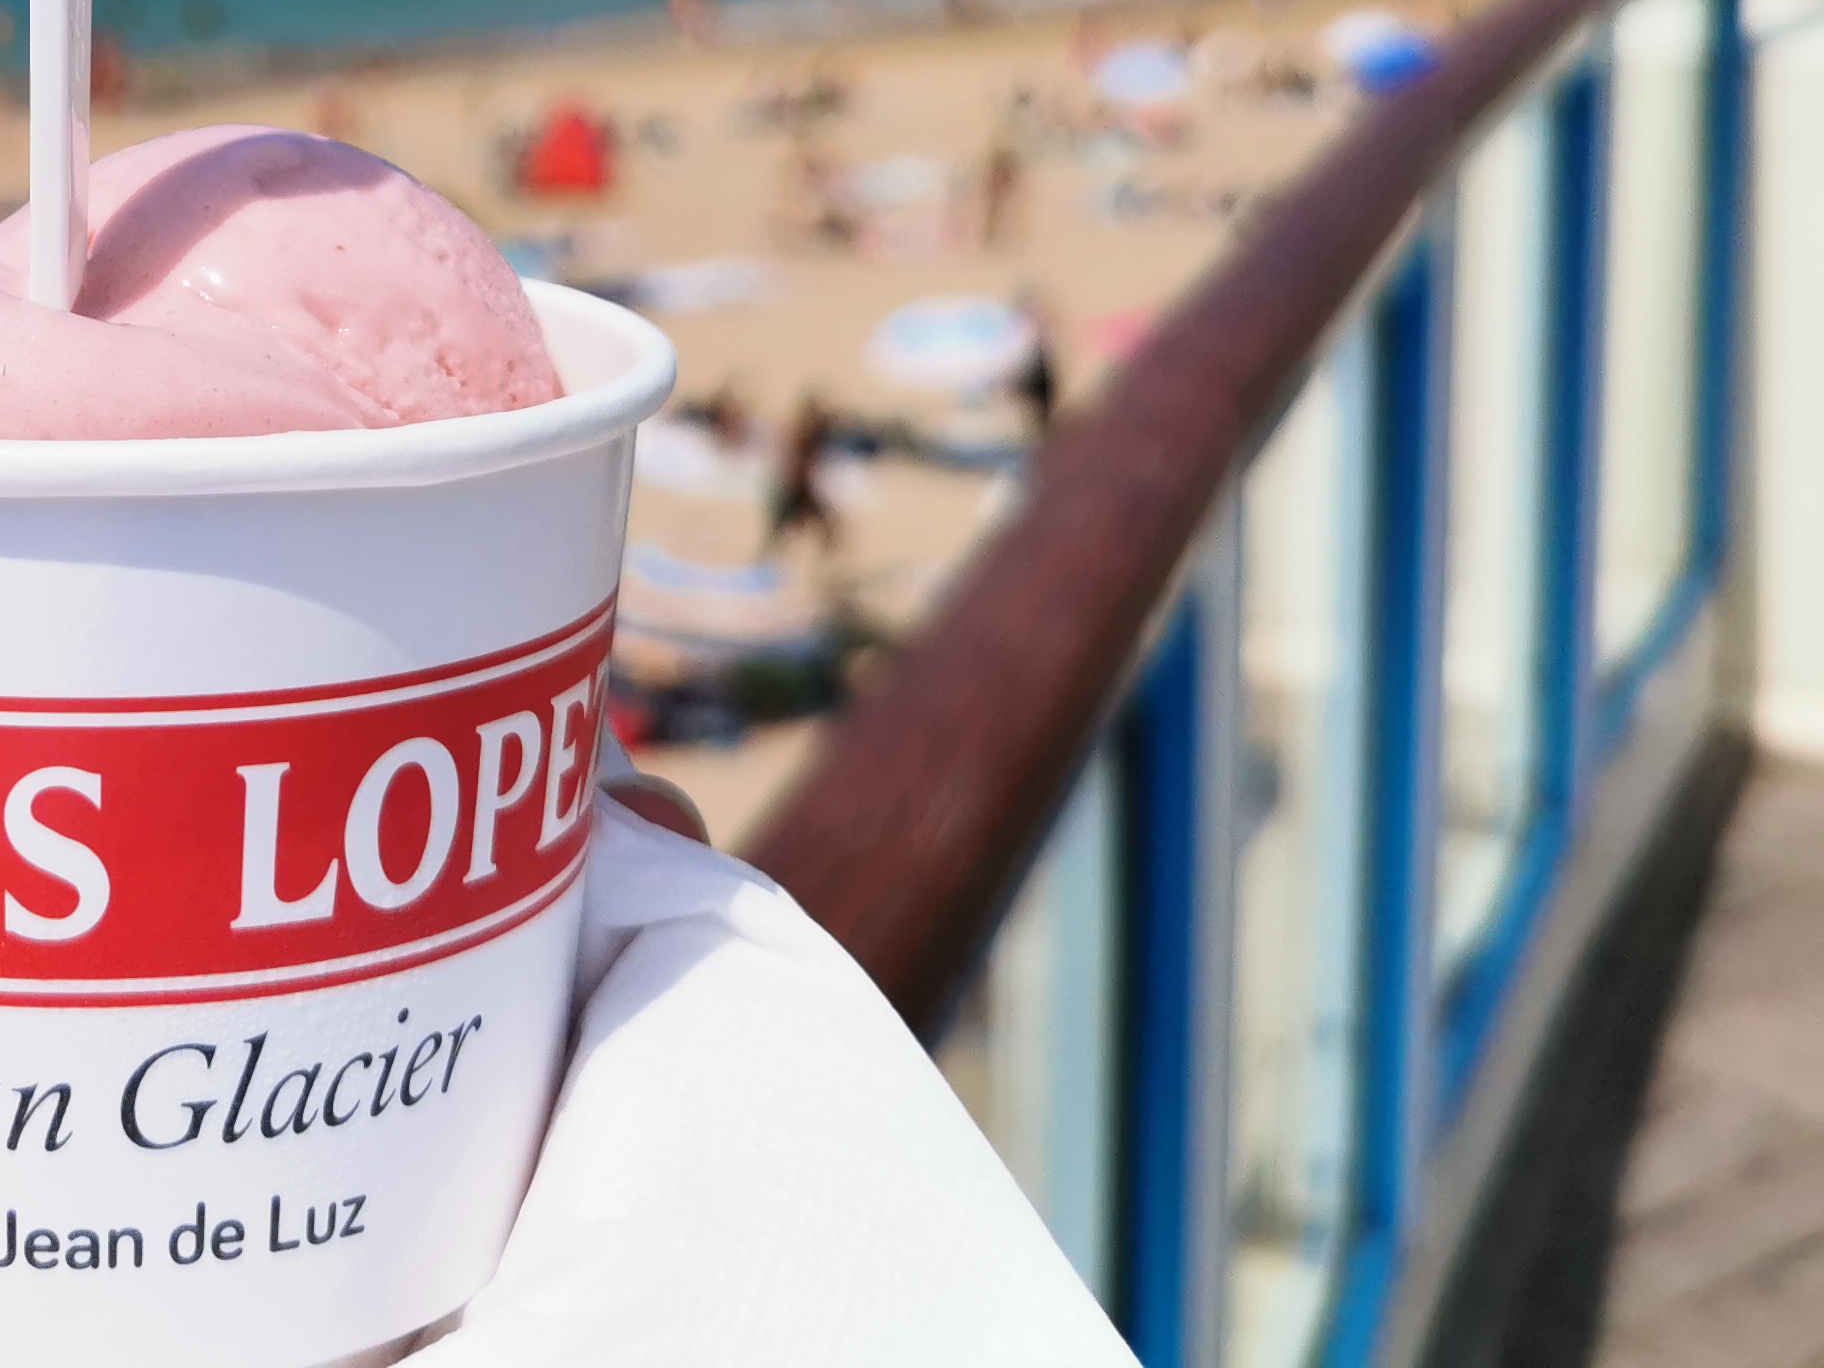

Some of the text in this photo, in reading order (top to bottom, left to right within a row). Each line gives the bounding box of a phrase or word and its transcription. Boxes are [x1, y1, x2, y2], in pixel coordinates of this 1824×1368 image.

[120, 1007, 483, 1150] Glacier
[168, 1202, 245, 1265] de
[269, 1194, 367, 1253] Luz
